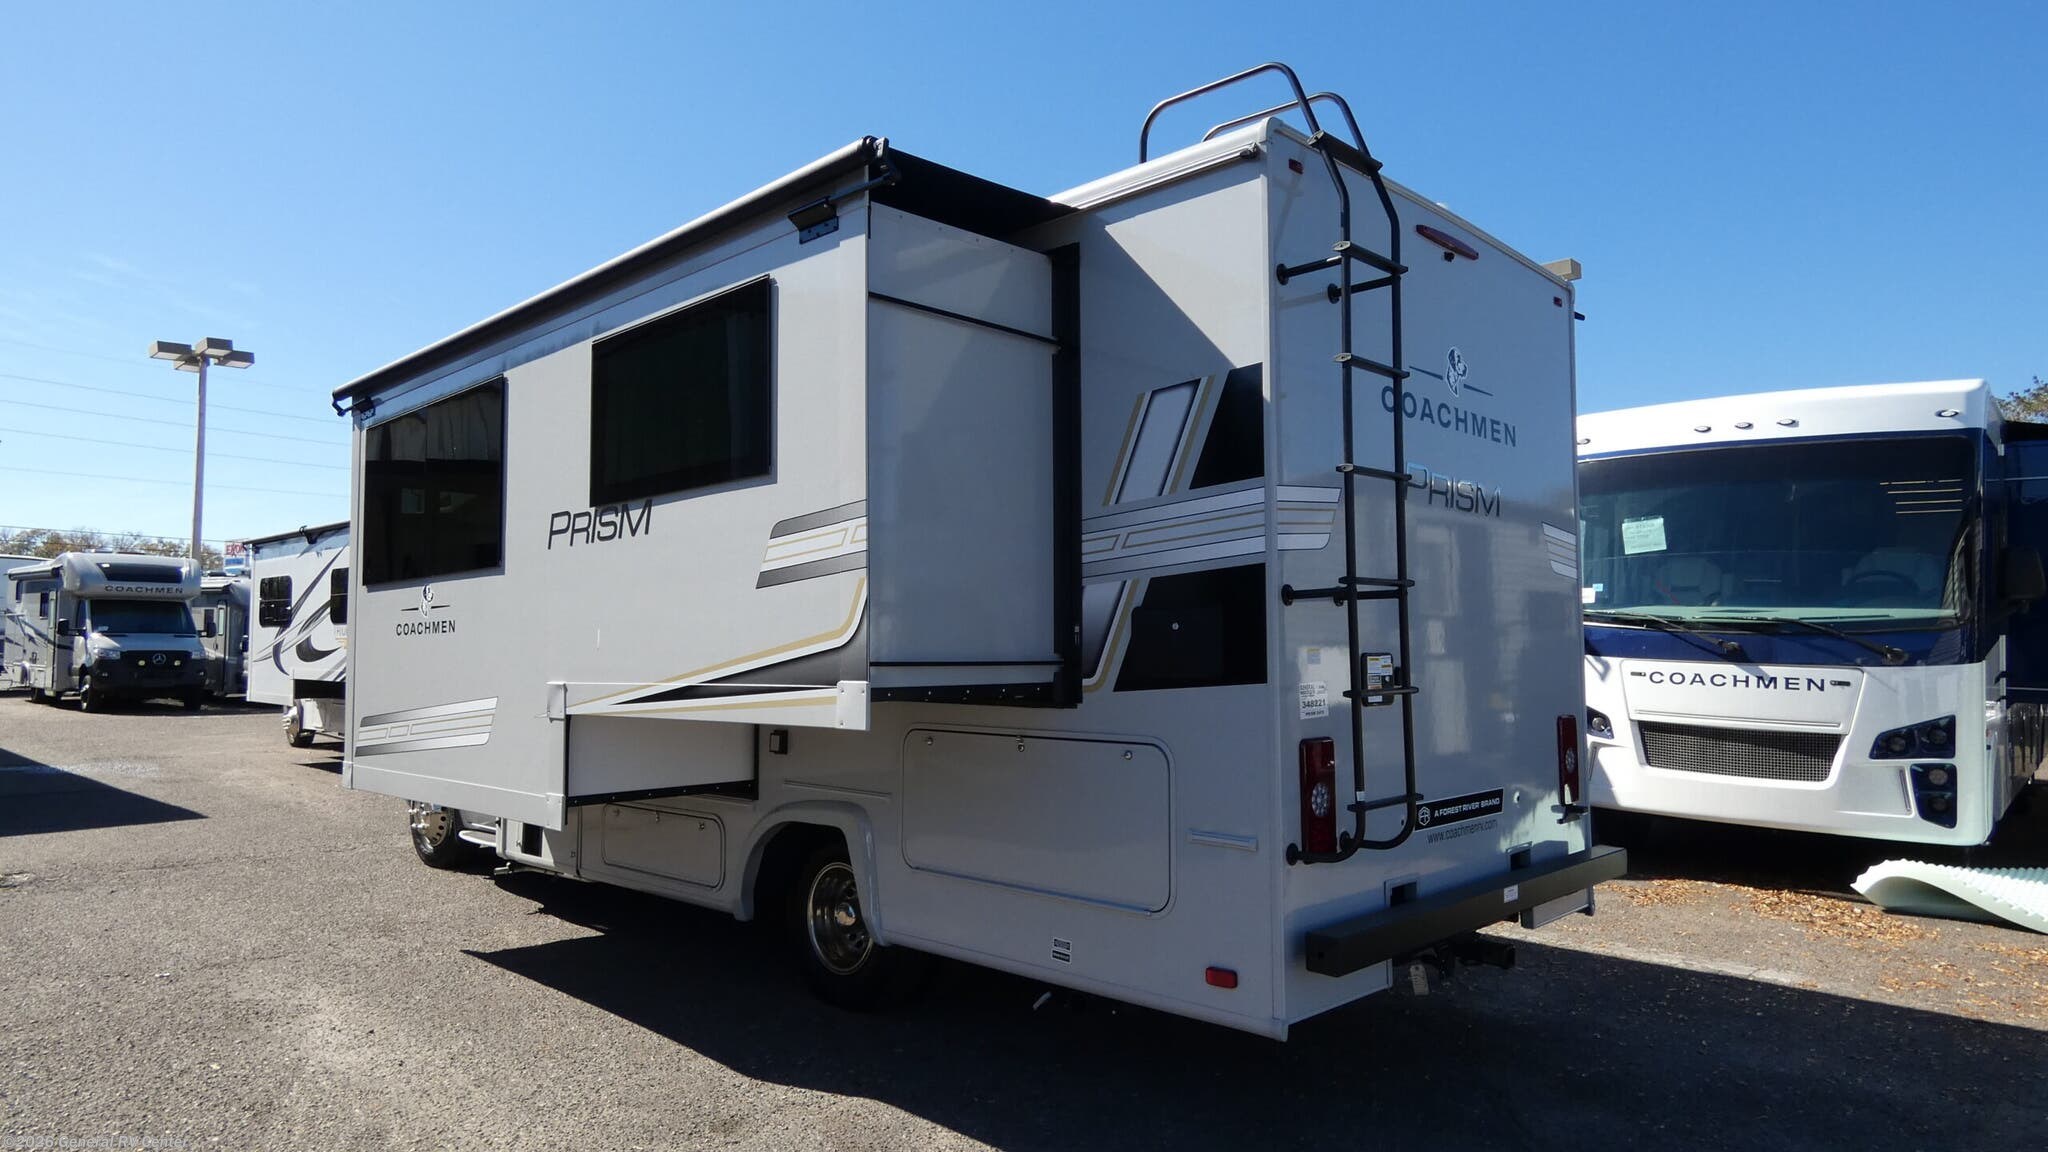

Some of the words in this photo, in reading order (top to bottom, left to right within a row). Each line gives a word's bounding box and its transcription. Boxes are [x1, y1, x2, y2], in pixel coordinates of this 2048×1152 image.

[1381, 385, 1517, 448] COACHMEN
[1405, 462, 1501, 517] PRISM
[547, 498, 653, 550] PRISM
[105, 585, 183, 594] COACHMEN
[395, 619, 456, 637] COACHMEN
[1649, 671, 1825, 691] COACHMEN
[1440, 806, 1462, 816] FOREST
[1462, 802, 1479, 811] RIVER
[1481, 798, 1499, 807] BRAND
